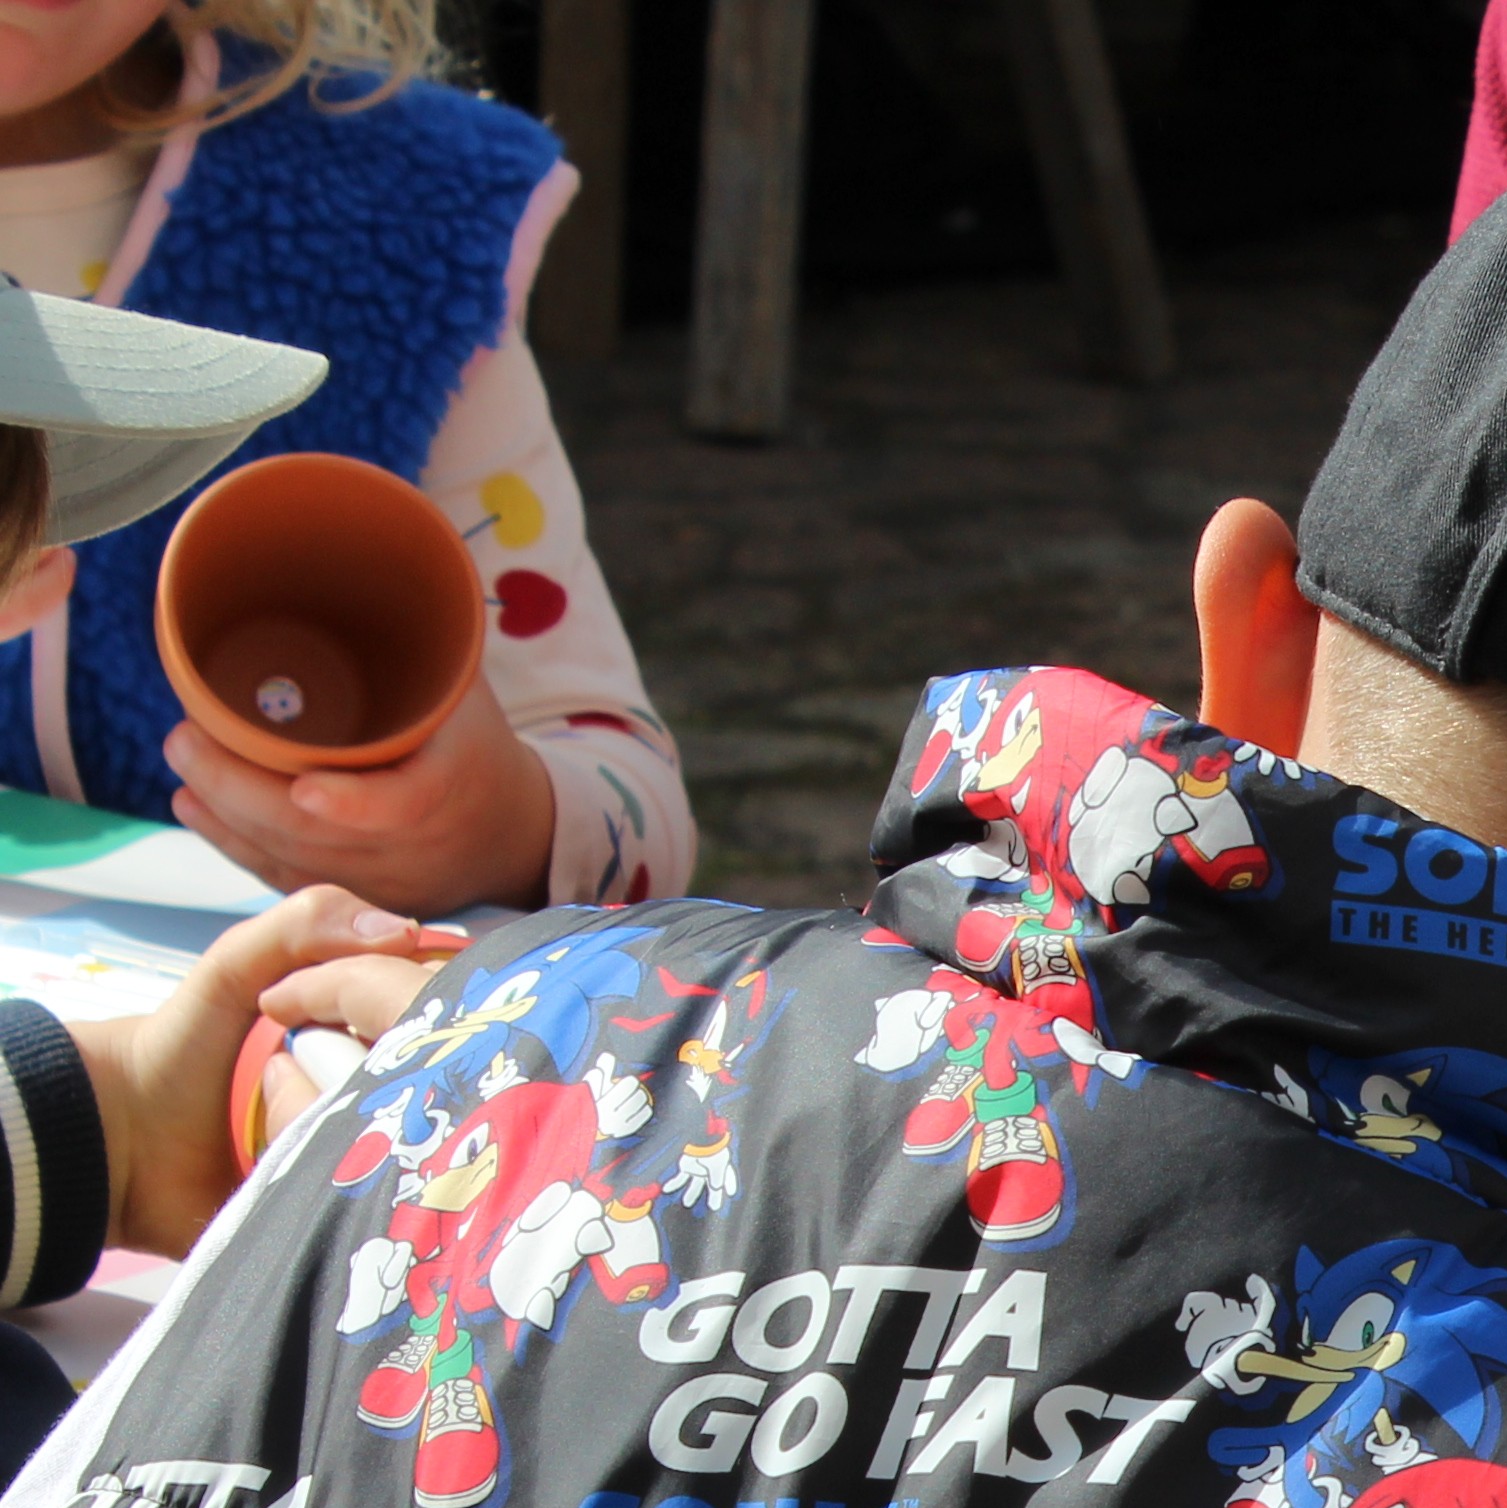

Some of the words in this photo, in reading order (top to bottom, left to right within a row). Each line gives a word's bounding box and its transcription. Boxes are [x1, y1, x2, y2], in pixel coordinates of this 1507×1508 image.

[1338, 907, 1419, 943] THE
[638, 1265, 1048, 1373] GOTTA
[649, 1373, 848, 1480] GO
[866, 1376, 1196, 1485] FAST
